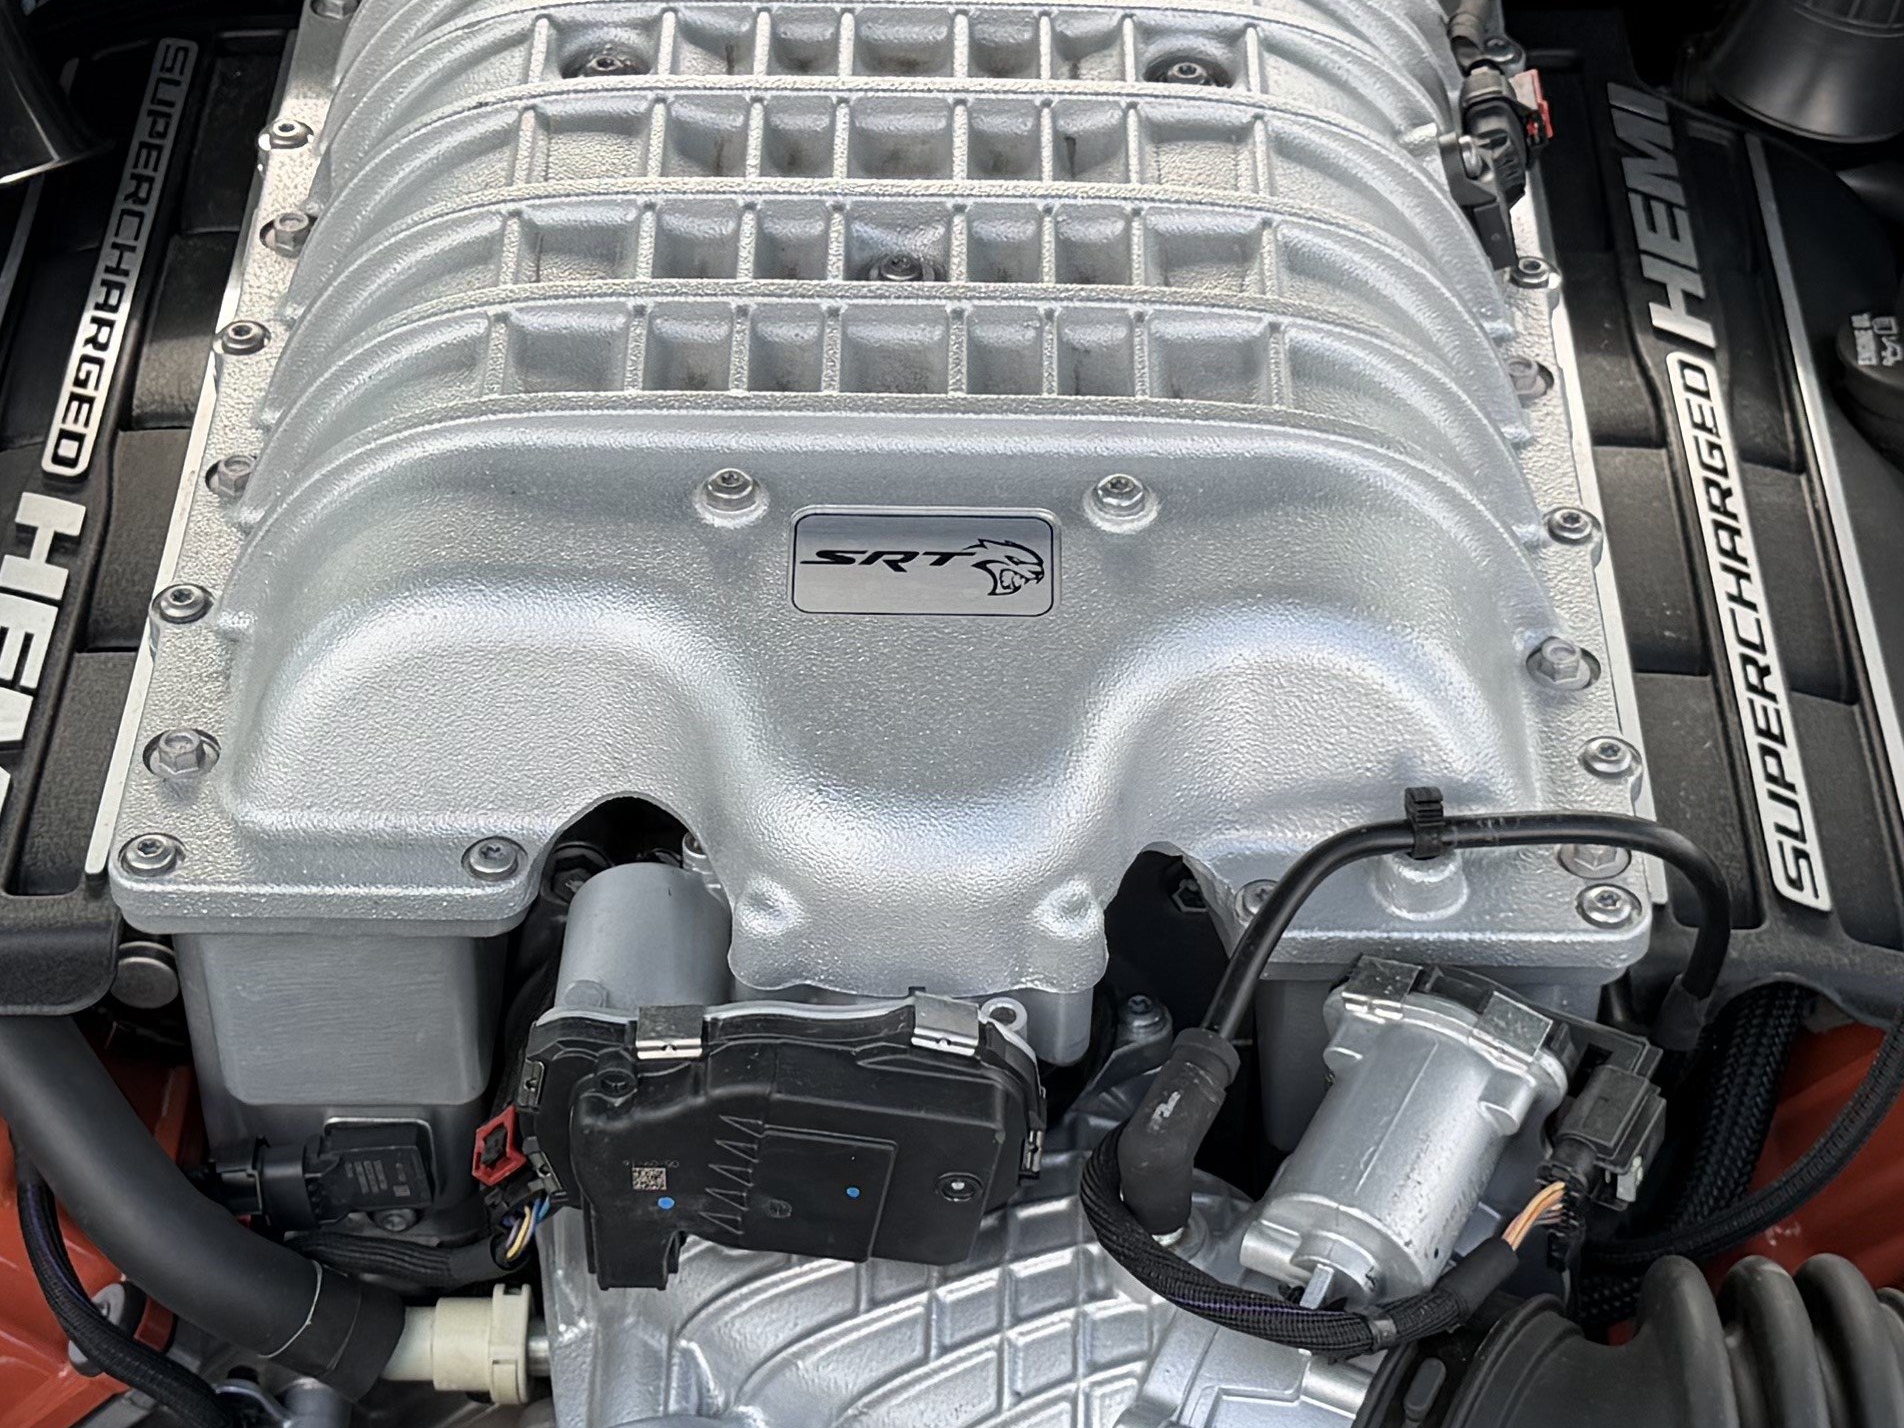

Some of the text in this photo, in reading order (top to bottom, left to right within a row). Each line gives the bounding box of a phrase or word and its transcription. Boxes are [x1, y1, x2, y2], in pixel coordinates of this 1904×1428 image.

[47, 42, 194, 472] SUPERCHARGED
[800, 549, 976, 573] SRT
[1607, 81, 1822, 903] SUPERCHARGED HEMI
